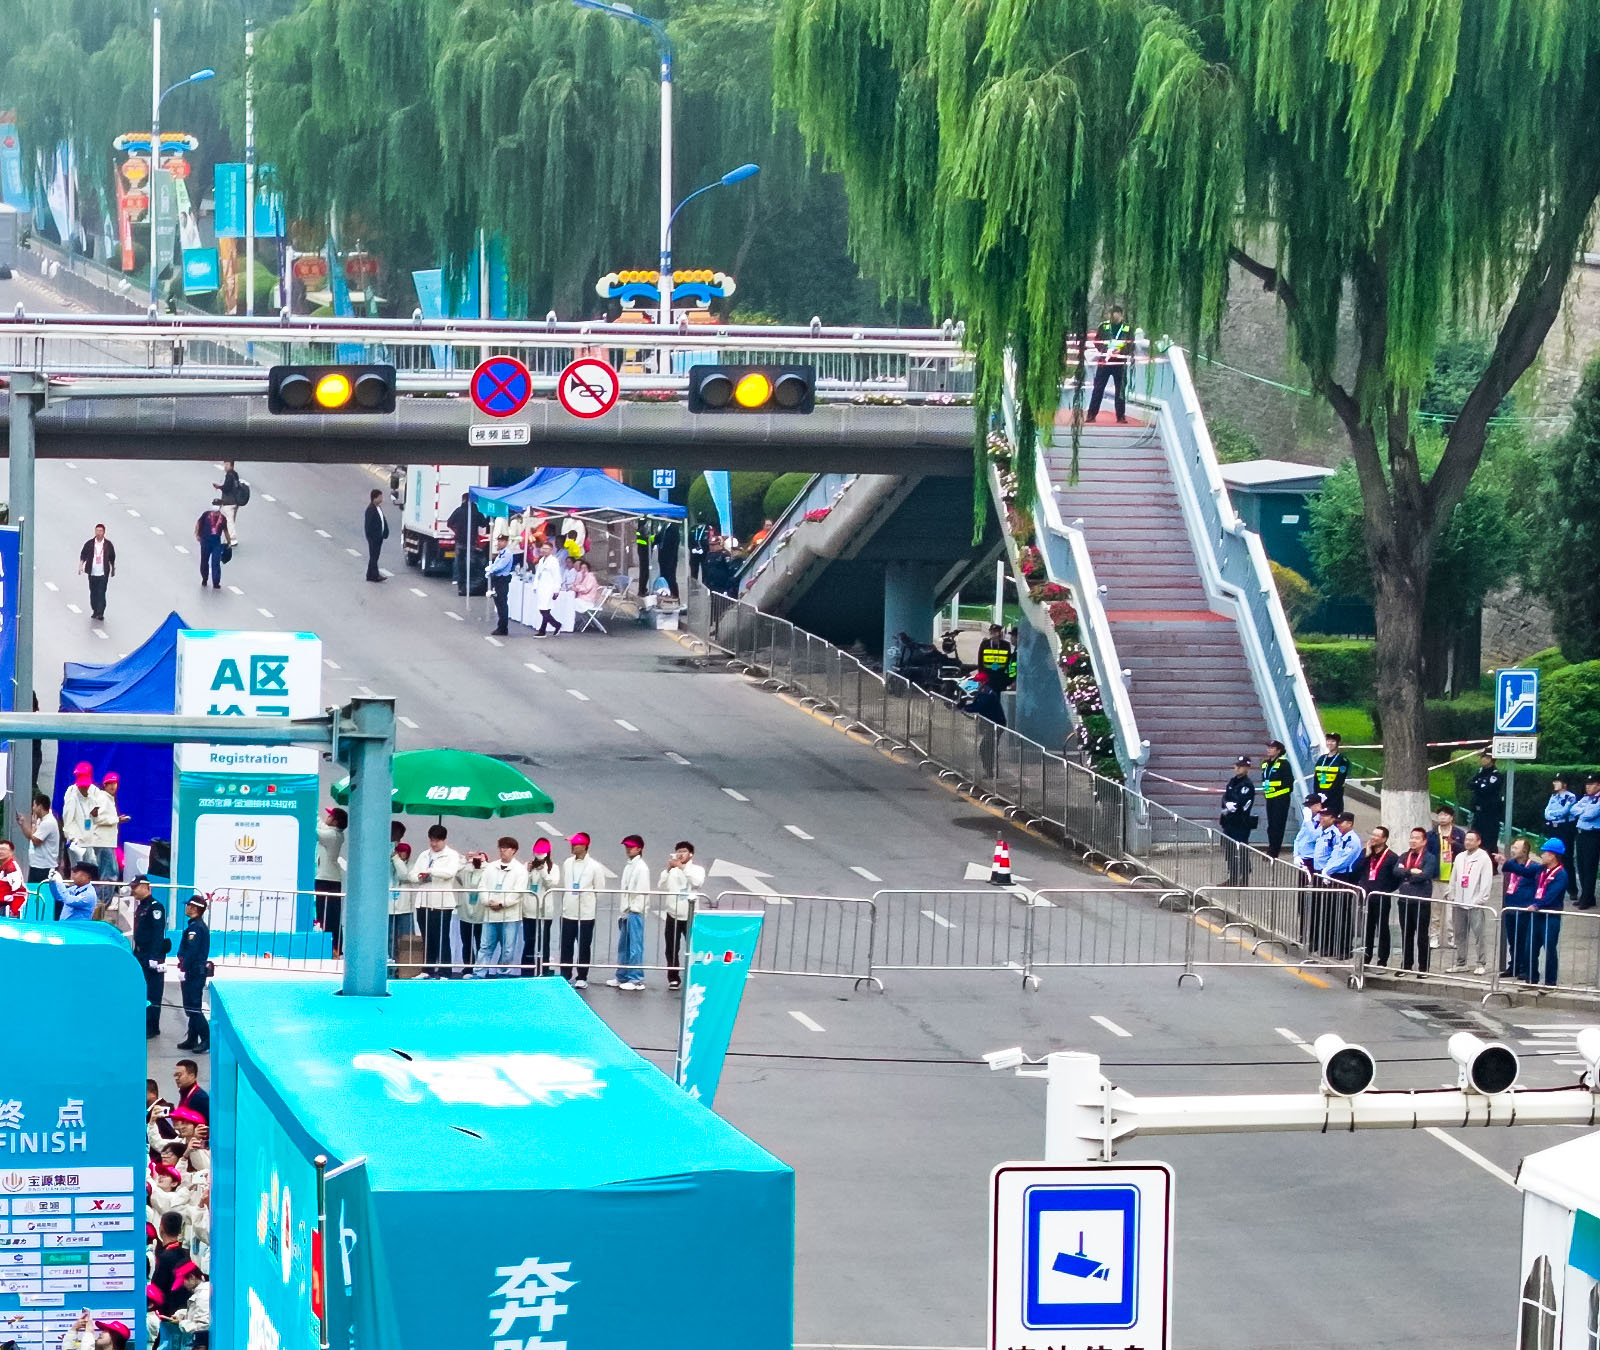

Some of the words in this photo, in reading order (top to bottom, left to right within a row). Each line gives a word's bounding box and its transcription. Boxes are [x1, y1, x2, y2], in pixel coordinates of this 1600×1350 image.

[476, 429, 524, 440] 视频监控
[210, 655, 290, 696] A区
[210, 752, 288, 766] Registration
[28, 1174, 80, 1187] 宝源集团
